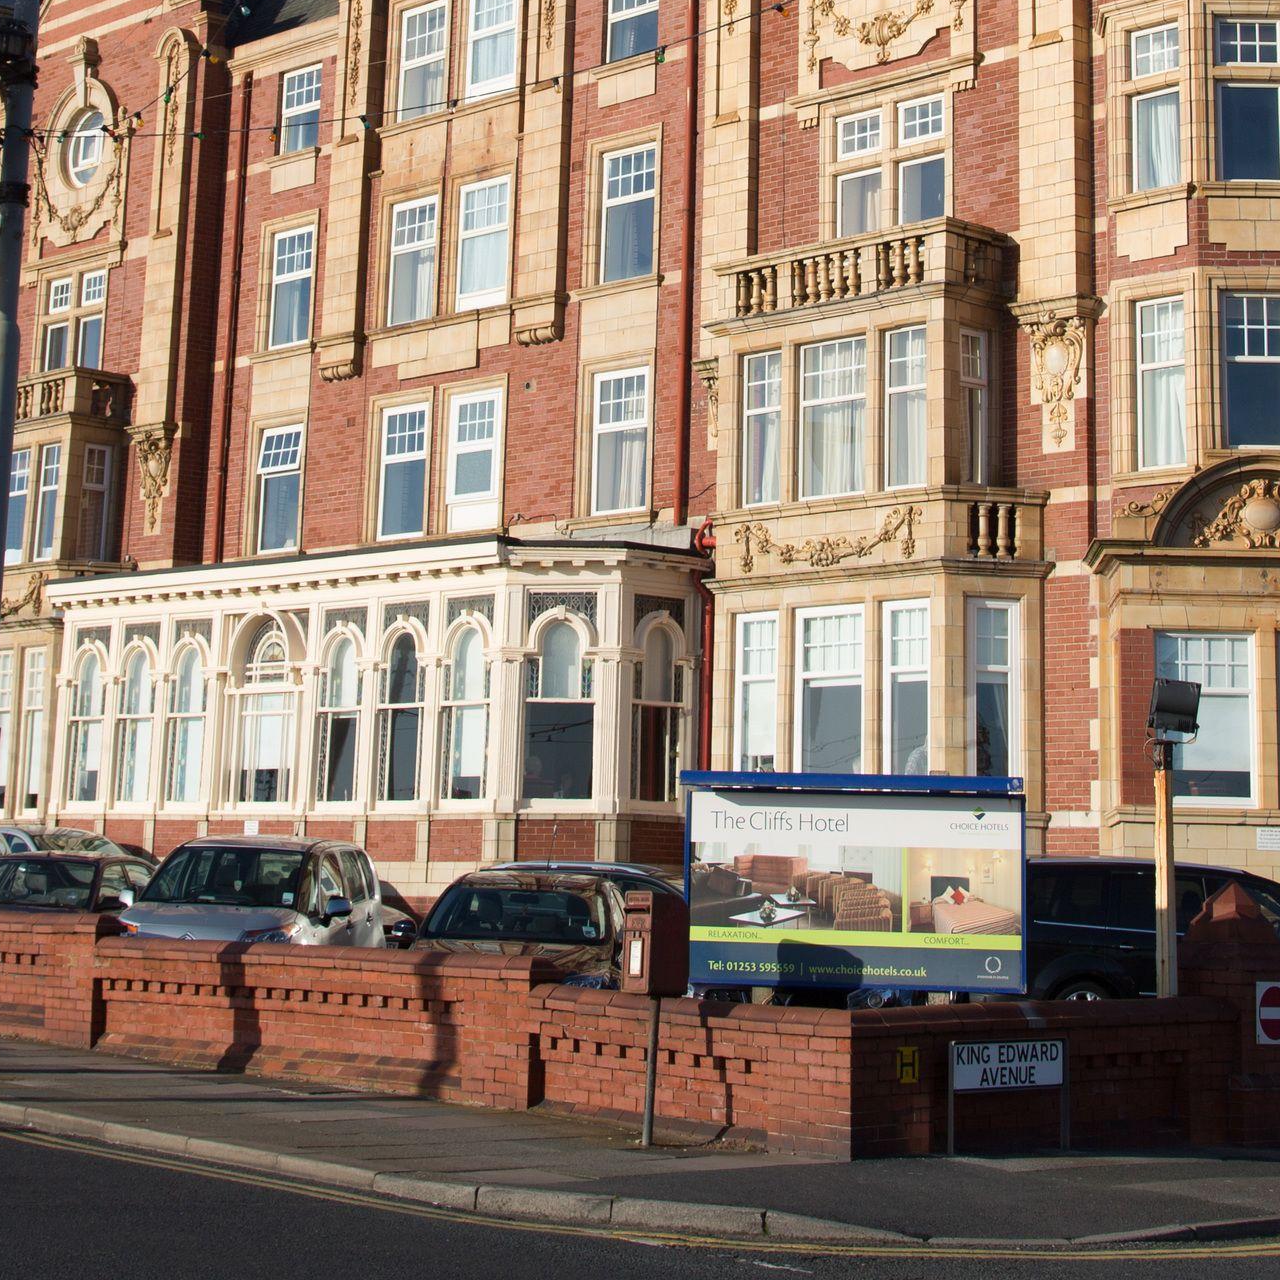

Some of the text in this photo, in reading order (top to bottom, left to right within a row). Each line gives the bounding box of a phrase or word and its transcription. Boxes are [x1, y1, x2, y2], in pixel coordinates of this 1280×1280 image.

[710, 810, 849, 832] The Cliffs Hotel
[950, 822, 1008, 831] CHOICE HOTELS
[707, 960, 927, 977] Tel: 01253 595559 www.choicehotels.co.uk
[956, 1043, 1059, 1066] KING EDWARD
[979, 1066, 1036, 1086] AVENUE
